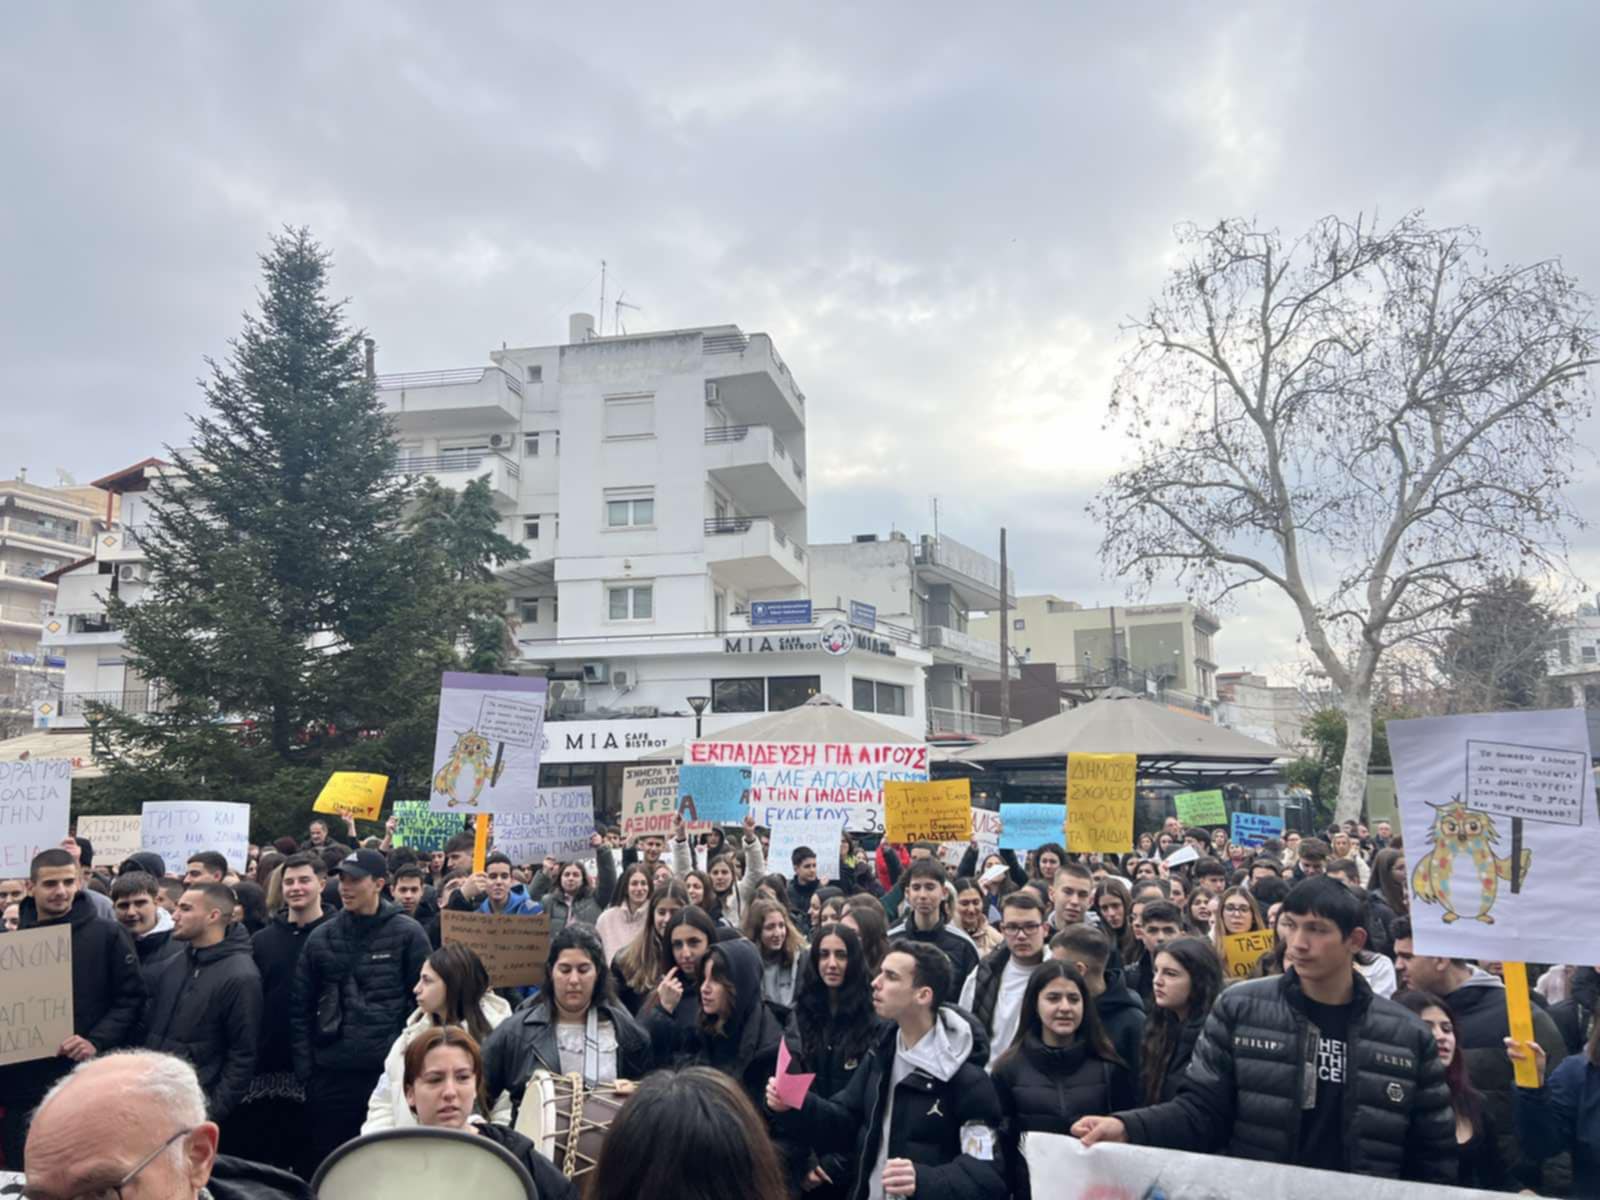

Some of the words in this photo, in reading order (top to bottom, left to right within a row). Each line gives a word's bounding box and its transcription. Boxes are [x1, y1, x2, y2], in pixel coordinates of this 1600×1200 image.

[725, 637, 774, 653] MIA
[565, 732, 619, 750] MIA
[624, 732, 649, 741] CAFE
[624, 739, 668, 748] BISTROT
[691, 743, 817, 766] ΕΚΠΑΙΔΕΥΣΗ
[825, 744, 852, 765] ΓΙΑ
[860, 746, 927, 769] ΛΙΓΟΥΣ
[774, 770, 804, 787] ΜΕ
[768, 787, 799, 802] ΤΗΝ
[805, 787, 873, 804] ΠΑΙΔΕΙΑ
[1071, 784, 1132, 801] ΣΧΟΛΕΙΟ
[146, 809, 201, 828] ΤΡΙΤΟ
[214, 812, 235, 825] ΚΑΙ
[907, 832, 959, 841] ΠΑΙΔΕΙΑ
[1375, 1053, 1413, 1069] PLEIN
